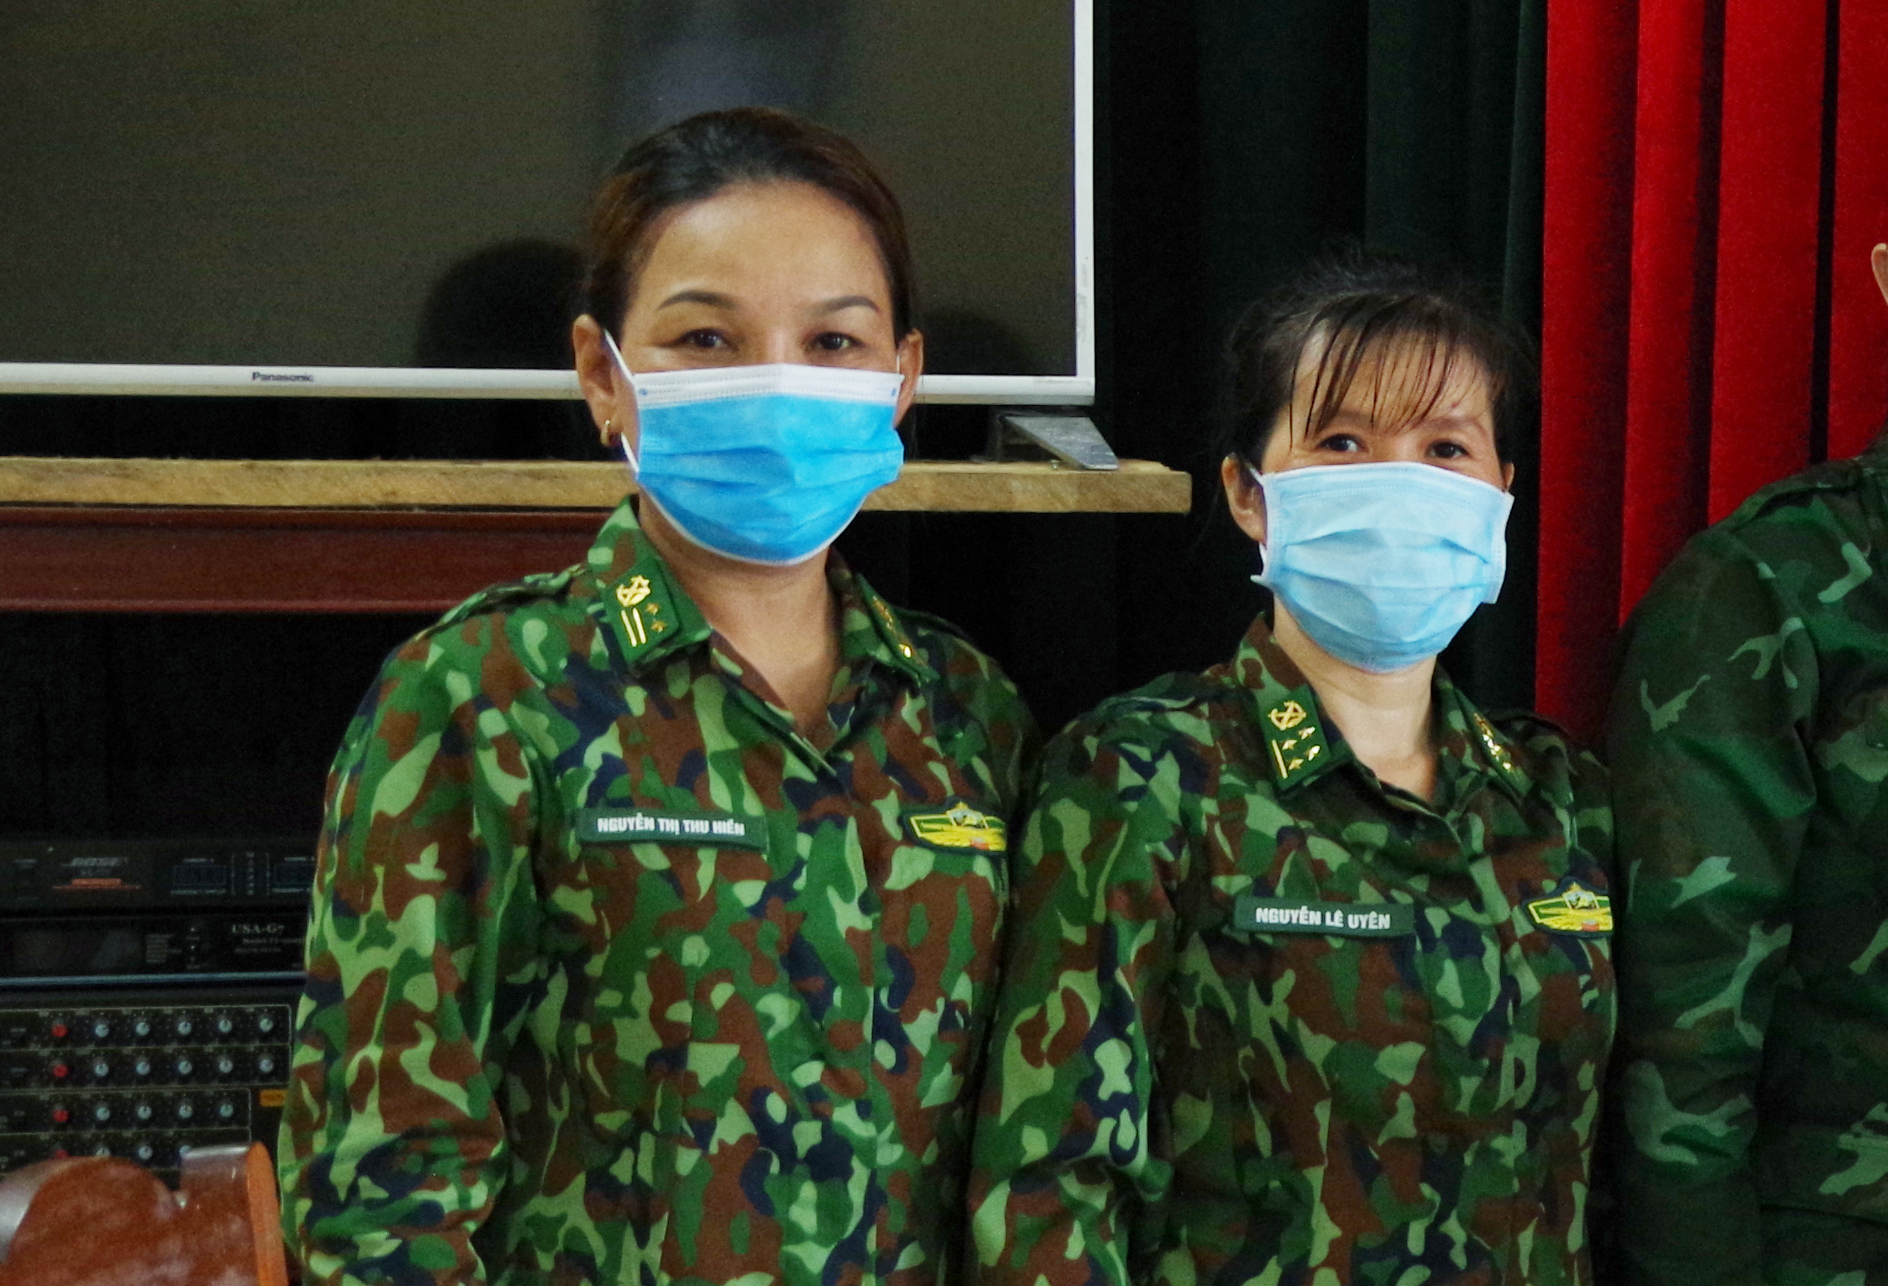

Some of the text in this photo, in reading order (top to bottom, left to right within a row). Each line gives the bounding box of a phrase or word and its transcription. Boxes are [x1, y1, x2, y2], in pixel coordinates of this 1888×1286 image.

[251, 371, 314, 382] Panasonic
[657, 817, 680, 835] THỊ
[682, 818, 710, 834] THU
[1325, 909, 1344, 928] LÊ
[1347, 910, 1391, 930] UYÊN
